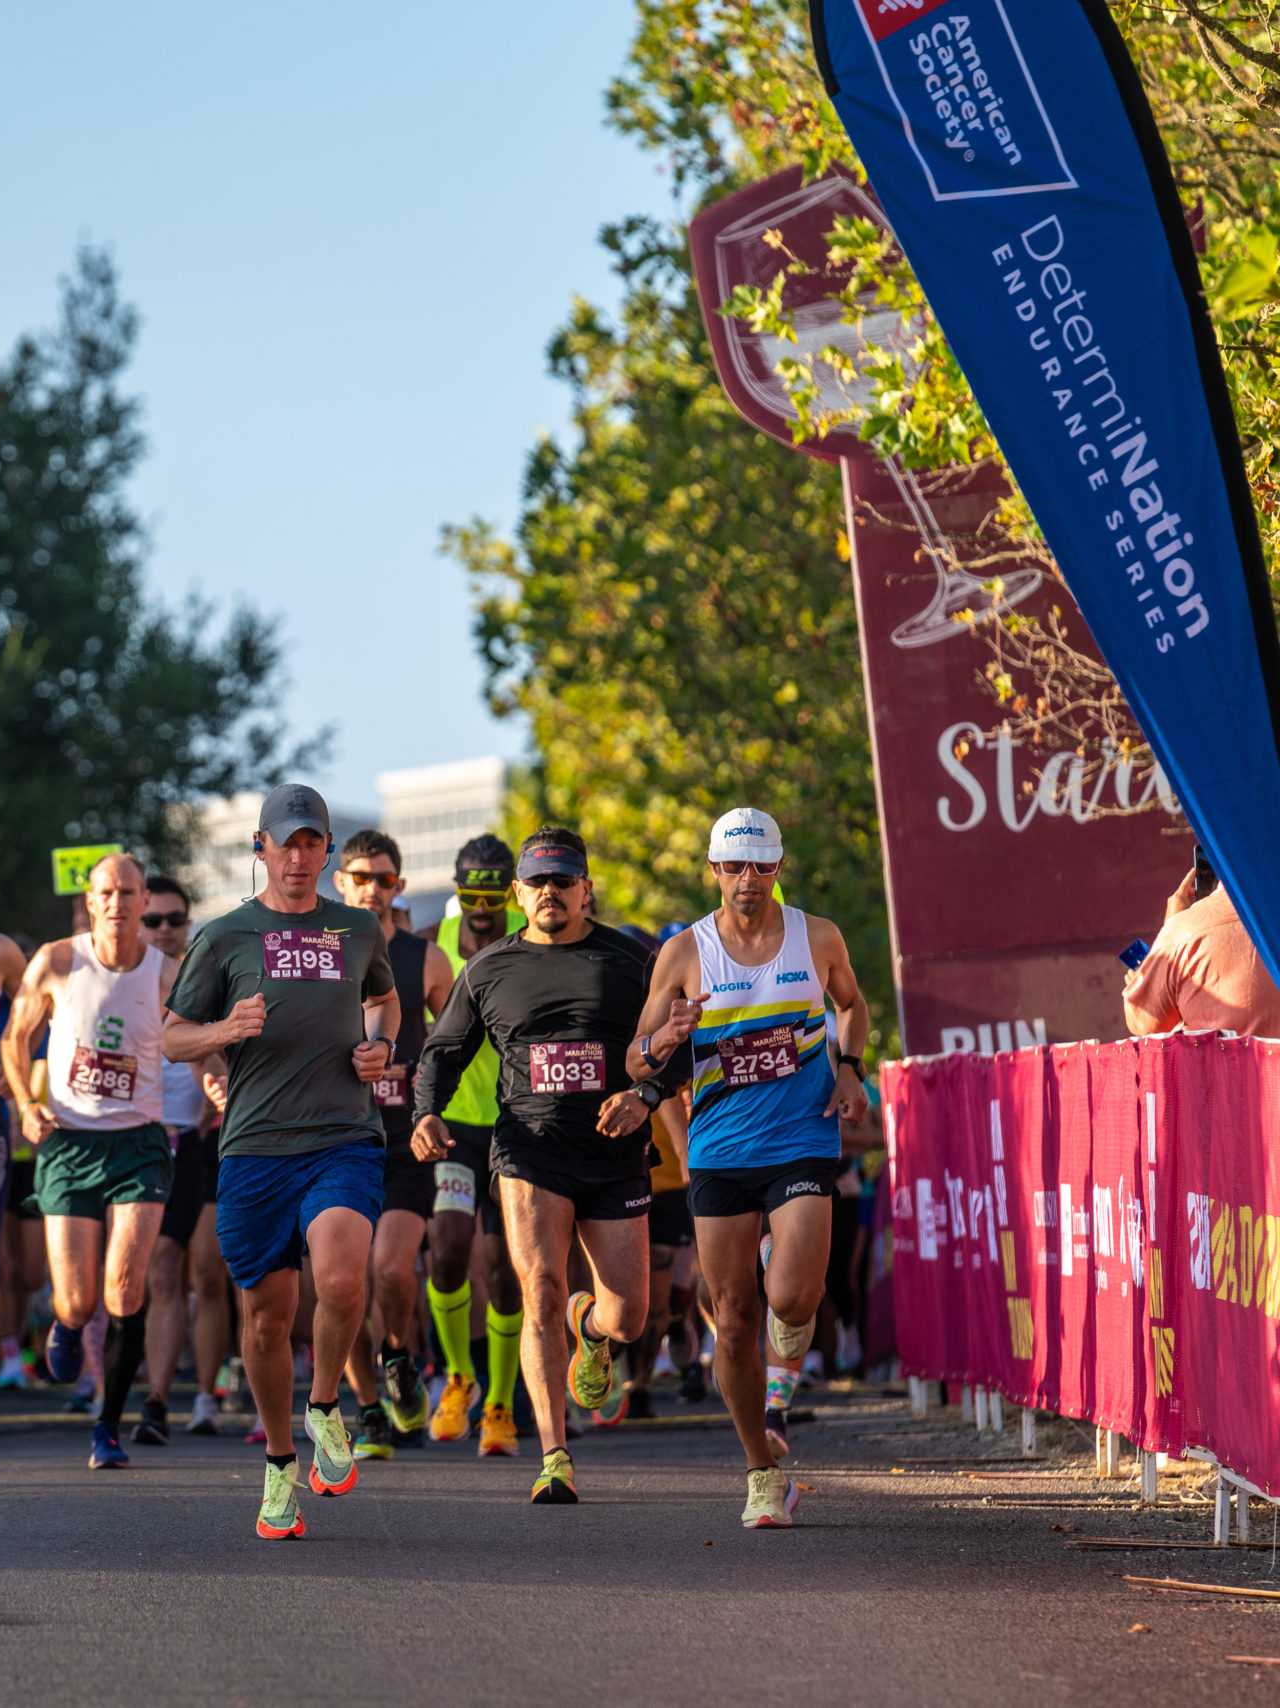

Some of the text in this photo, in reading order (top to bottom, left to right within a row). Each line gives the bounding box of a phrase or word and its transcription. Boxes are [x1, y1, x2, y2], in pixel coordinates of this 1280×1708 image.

[931, 22, 984, 132] Cancer
[948, 15, 1022, 166] American
[1021, 214, 1210, 639] DetermiNation
[992, 243, 1175, 654] ENDURANCE SERIES
[724, 827, 753, 838] HOKA
[301, 937, 340, 946] MARATHON
[276, 949, 335, 970] 2198
[711, 982, 752, 993] AGGIES
[776, 971, 810, 985] HOKA
[752, 1033, 792, 1047] MARATHON
[773, 1027, 791, 1037] HALF
[731, 1048, 790, 1075] 2734
[74, 1064, 131, 1090] 2086
[541, 1062, 596, 1083] 1033
[785, 1181, 822, 1196] HOKA
